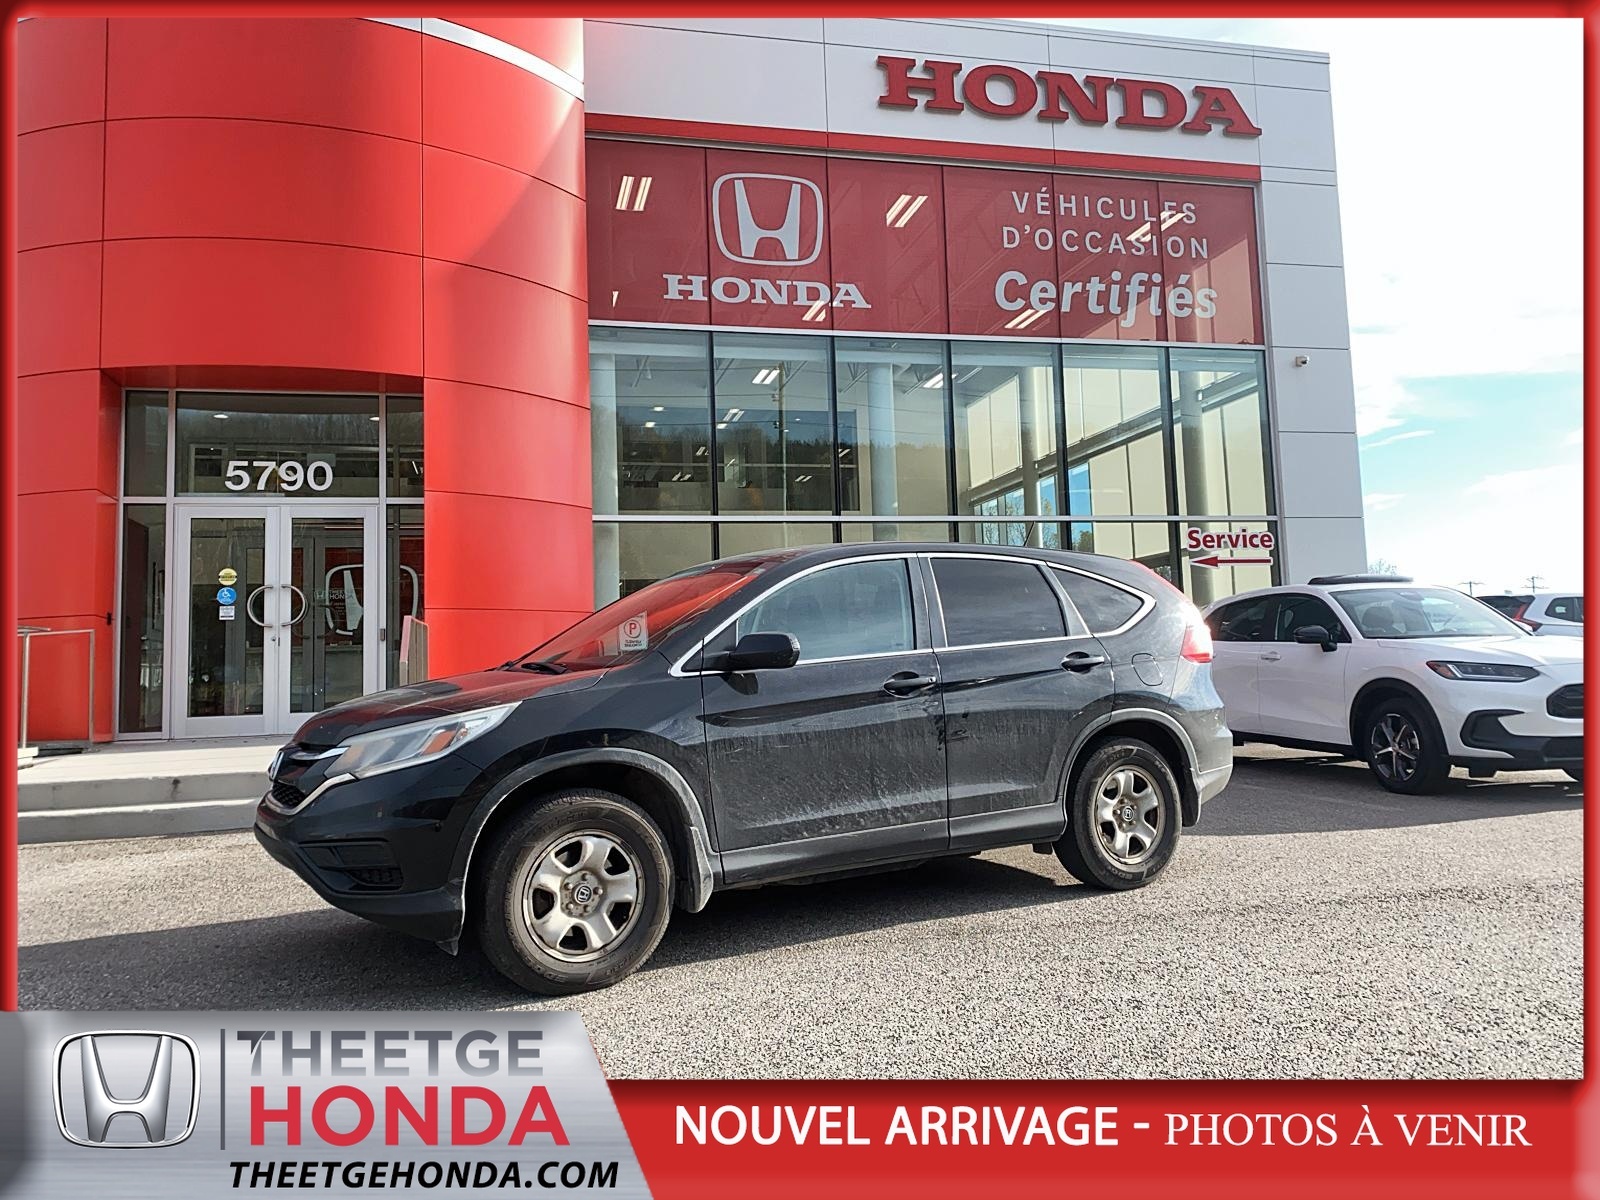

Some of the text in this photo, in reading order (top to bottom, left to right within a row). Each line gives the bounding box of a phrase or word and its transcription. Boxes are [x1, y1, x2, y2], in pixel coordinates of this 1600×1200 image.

[876, 55, 1262, 137] HONDA
[1011, 187, 1197, 225] VÉHICULES
[662, 274, 871, 309] HONDA
[994, 271, 1217, 328] Certifiés
[224, 460, 333, 491] 5790
[1187, 528, 1274, 549] Service
